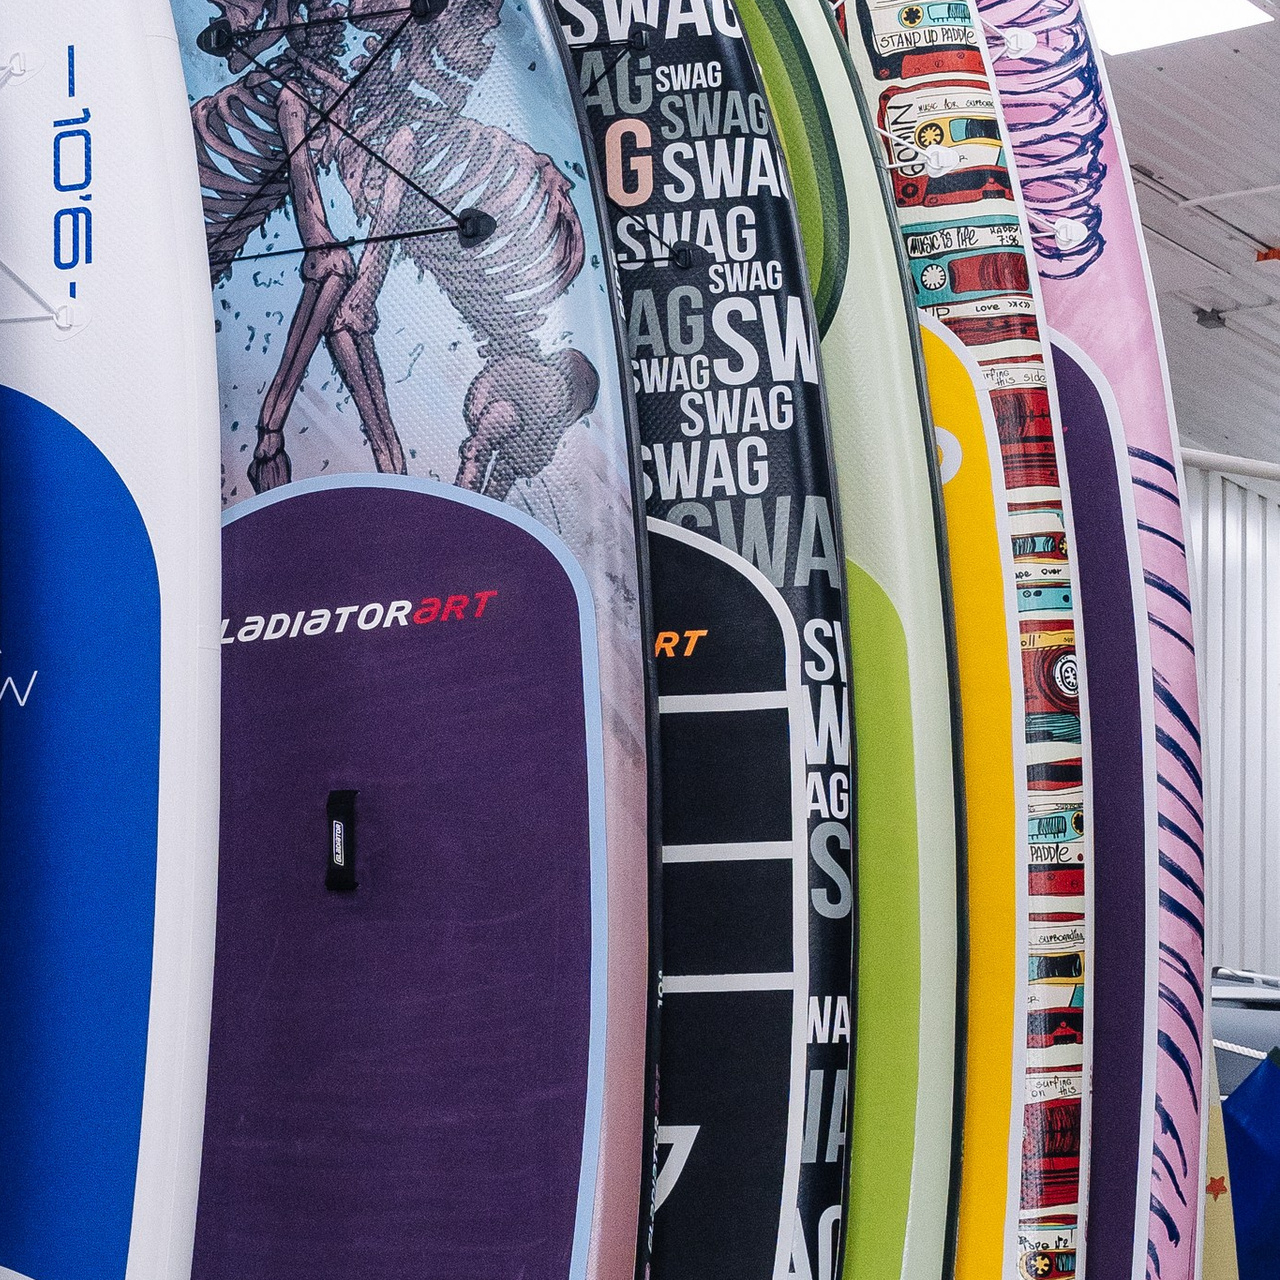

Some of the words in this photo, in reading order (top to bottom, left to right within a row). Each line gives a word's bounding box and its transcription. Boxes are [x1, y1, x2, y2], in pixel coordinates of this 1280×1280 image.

[655, 61, 723, 93] SWAG
[660, 90, 769, 140] SWAG
[605, 118, 654, 208] G
[663, 138, 790, 203] SWA
[616, 205, 758, 271] SWAG
[708, 261, 784, 294] SWAG
[631, 354, 711, 395] SWAG
[680, 385, 795, 437] SWAG
[643, 436, 769, 502] SWAG
[334, 823, 343, 864] GLADIATOR
